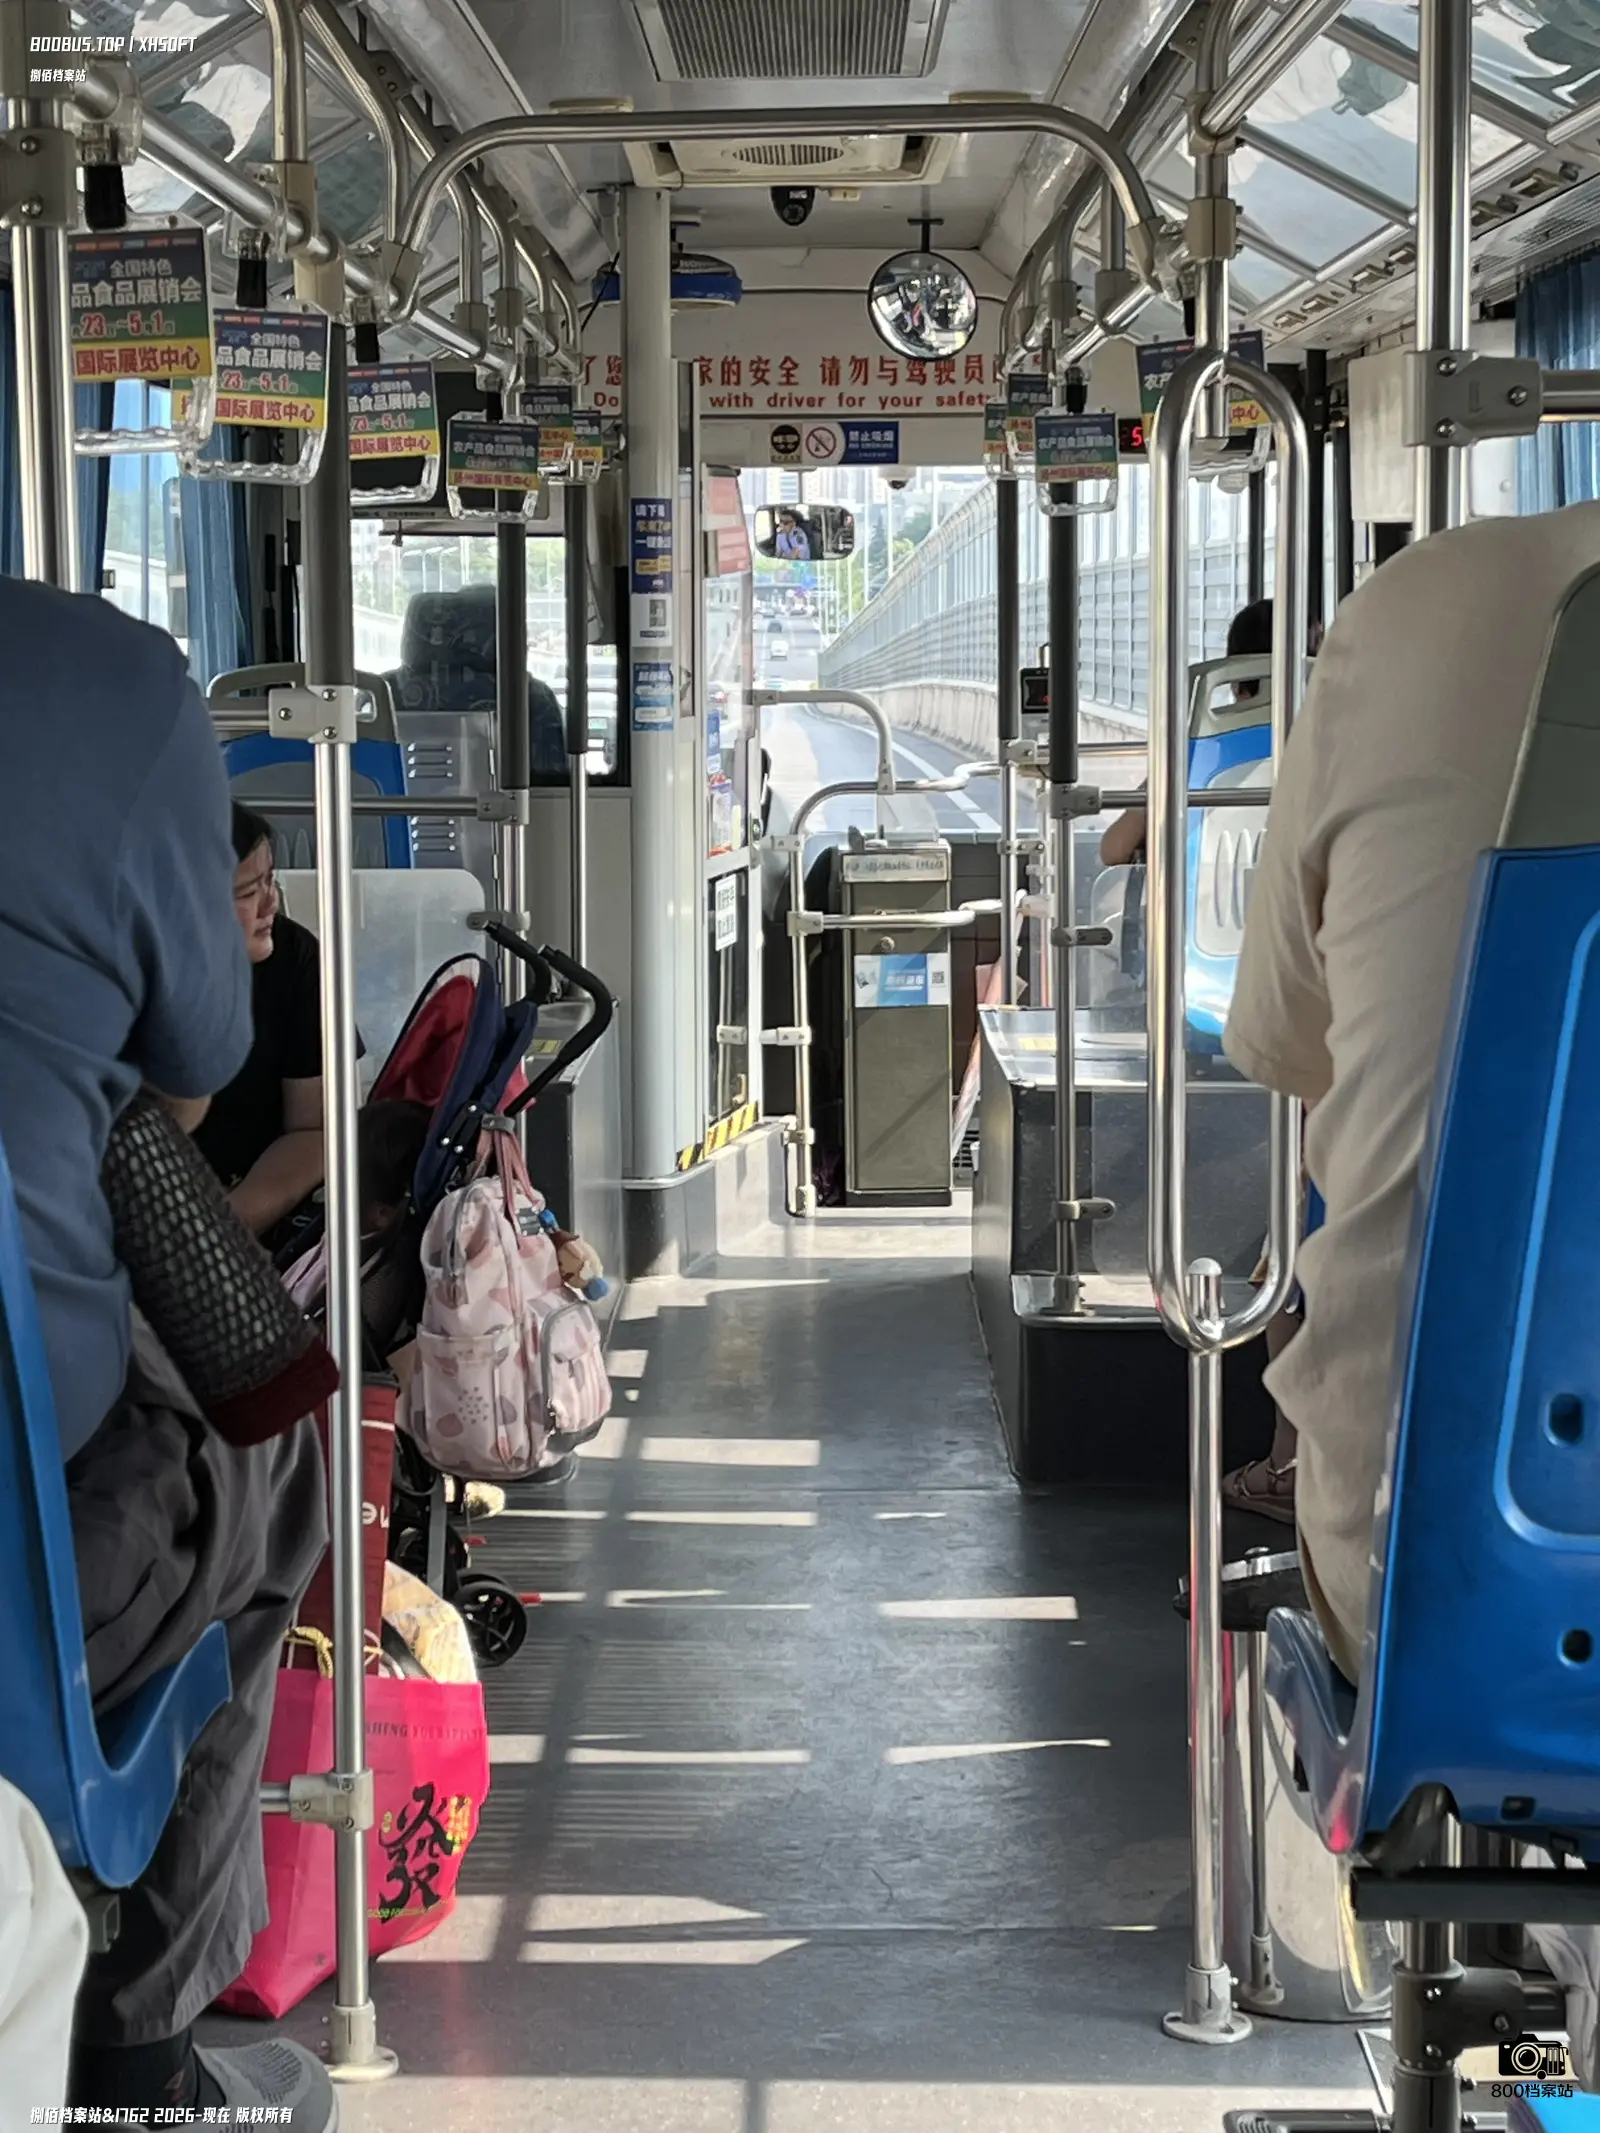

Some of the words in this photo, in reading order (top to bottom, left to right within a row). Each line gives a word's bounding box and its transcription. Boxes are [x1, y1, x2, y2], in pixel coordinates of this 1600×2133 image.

[110, 257, 172, 279] 全国特色
[76, 344, 201, 376] 国际展览中心
[215, 397, 316, 423] 国际展览中心
[593, 392, 620, 408] Do
[709, 392, 754, 408] with
[766, 391, 826, 408] driver
[838, 391, 866, 408] for
[878, 394, 923, 410] your
